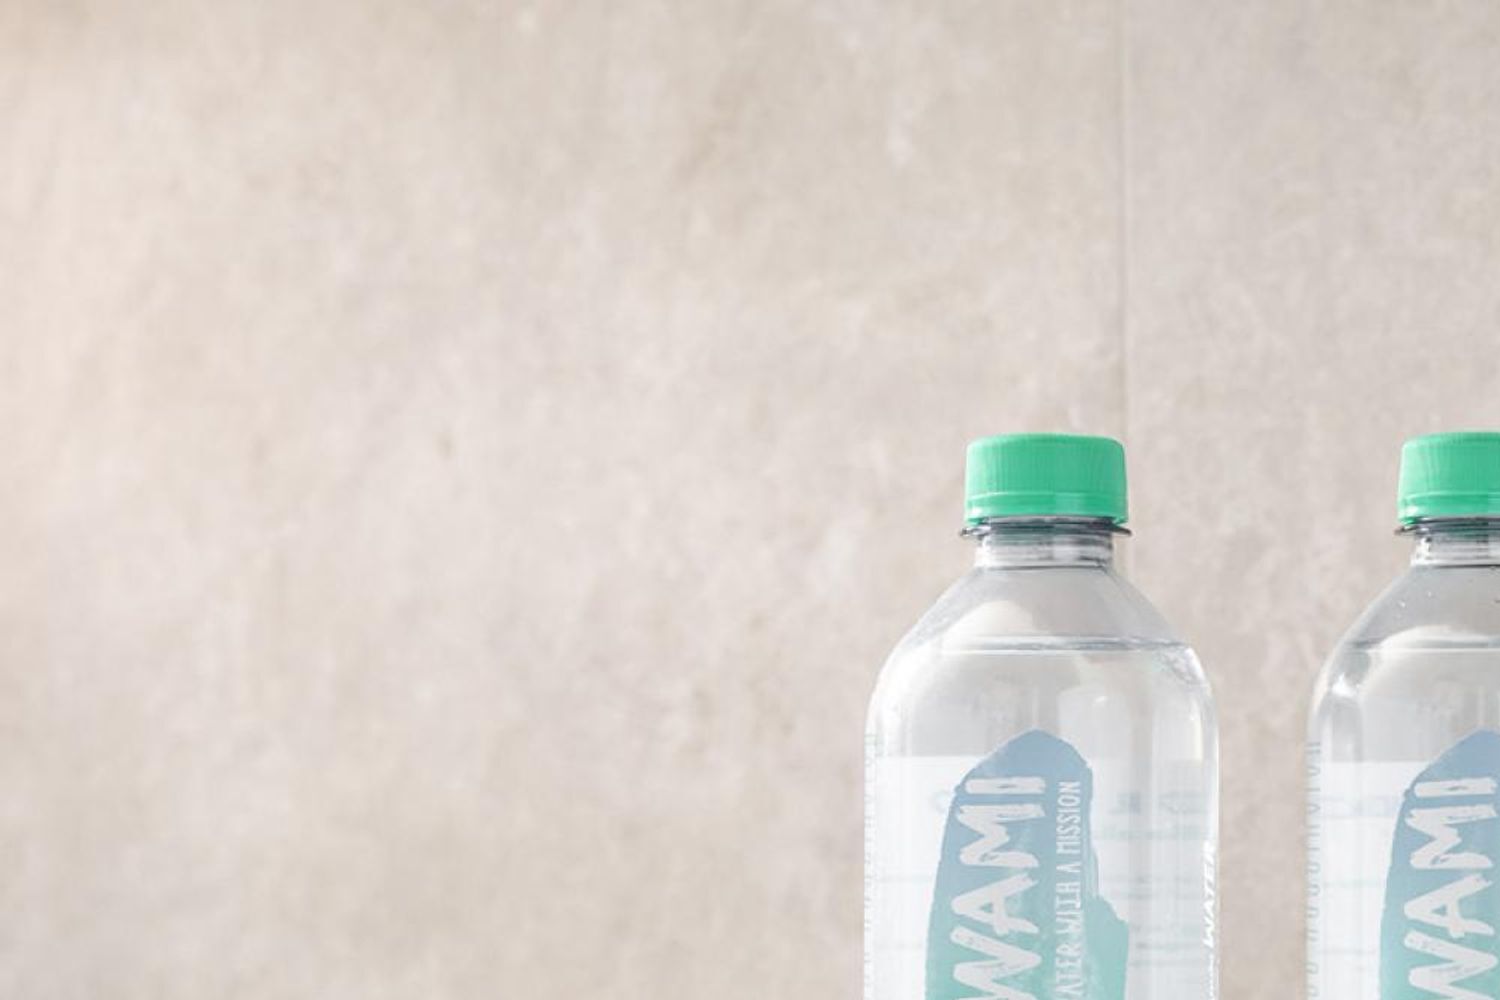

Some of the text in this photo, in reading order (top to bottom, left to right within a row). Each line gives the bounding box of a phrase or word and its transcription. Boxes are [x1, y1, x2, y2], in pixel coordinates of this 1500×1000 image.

[1056, 781, 1082, 855] MISSION
[1057, 860, 1082, 874] A
[1056, 876, 1083, 936] WITH
